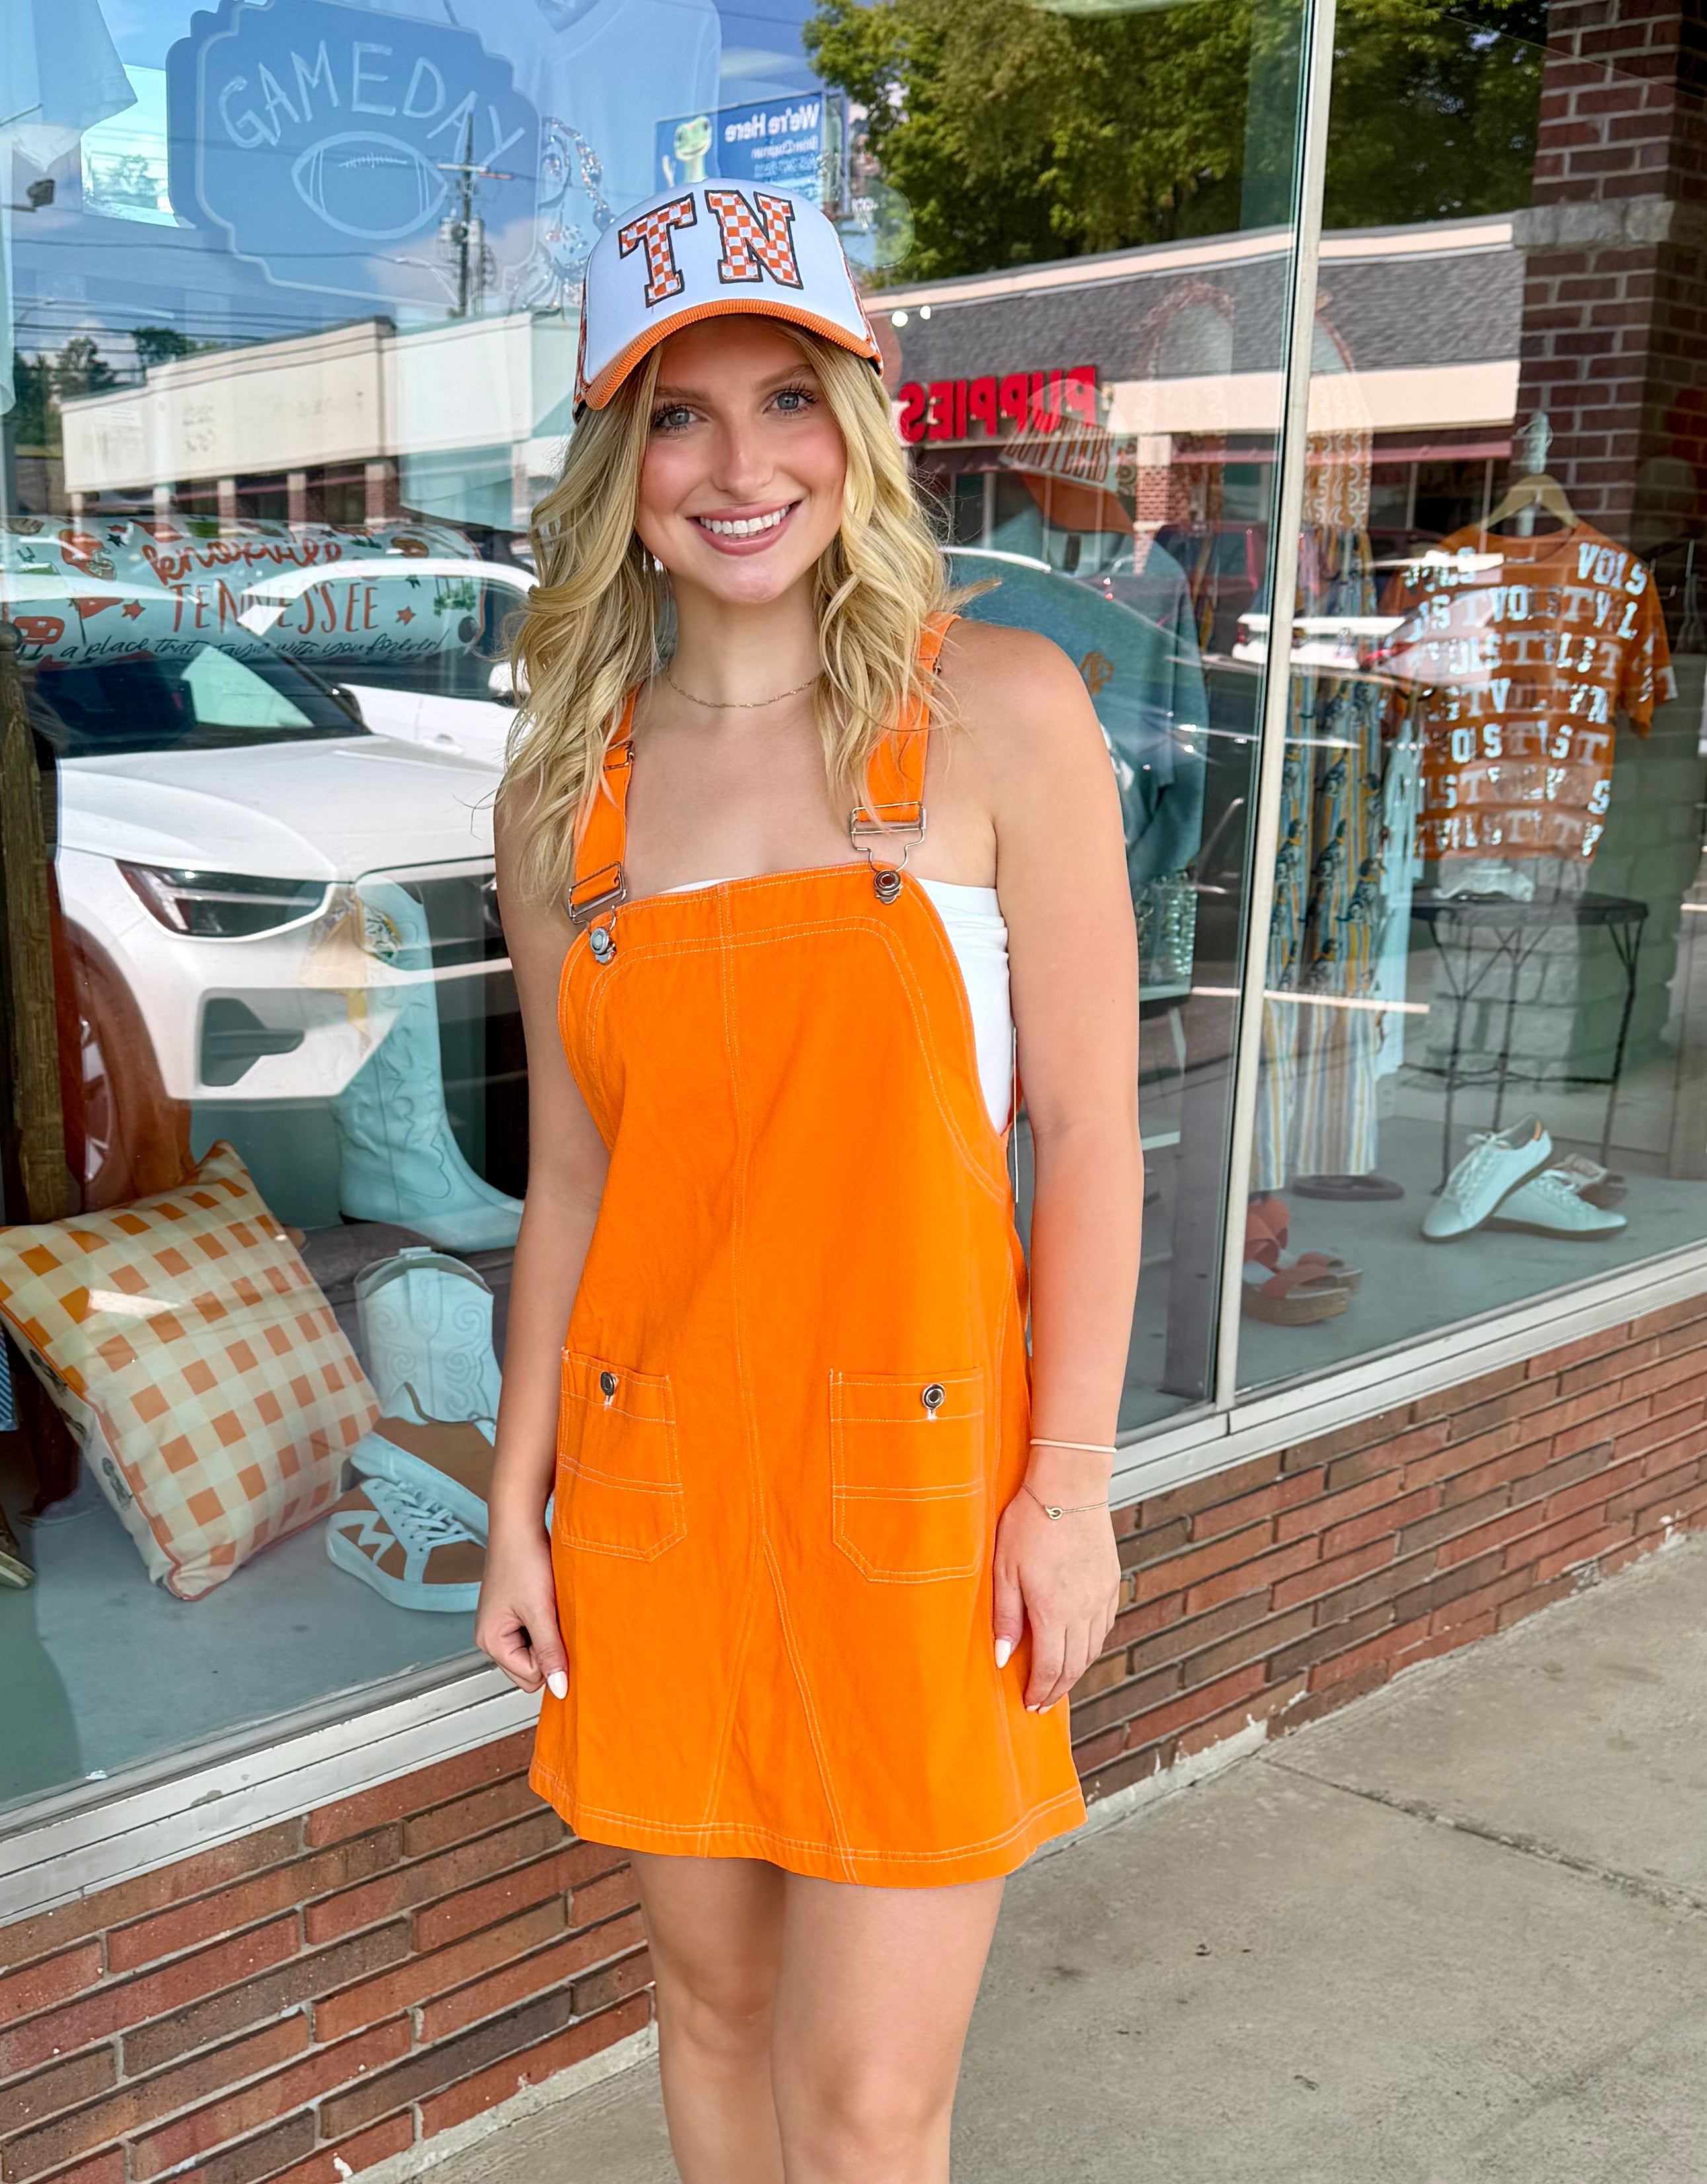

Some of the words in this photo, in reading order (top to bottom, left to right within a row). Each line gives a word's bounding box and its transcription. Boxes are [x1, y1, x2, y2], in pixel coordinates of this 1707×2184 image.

[218, 40, 525, 166] GAMEDAY
[618, 189, 804, 308] TN
[1577, 542, 1648, 595] VOLS
[59, 645, 78, 658] a
[85, 635, 150, 656] place
[155, 639, 205, 655] that
[322, 642, 364, 658] you
